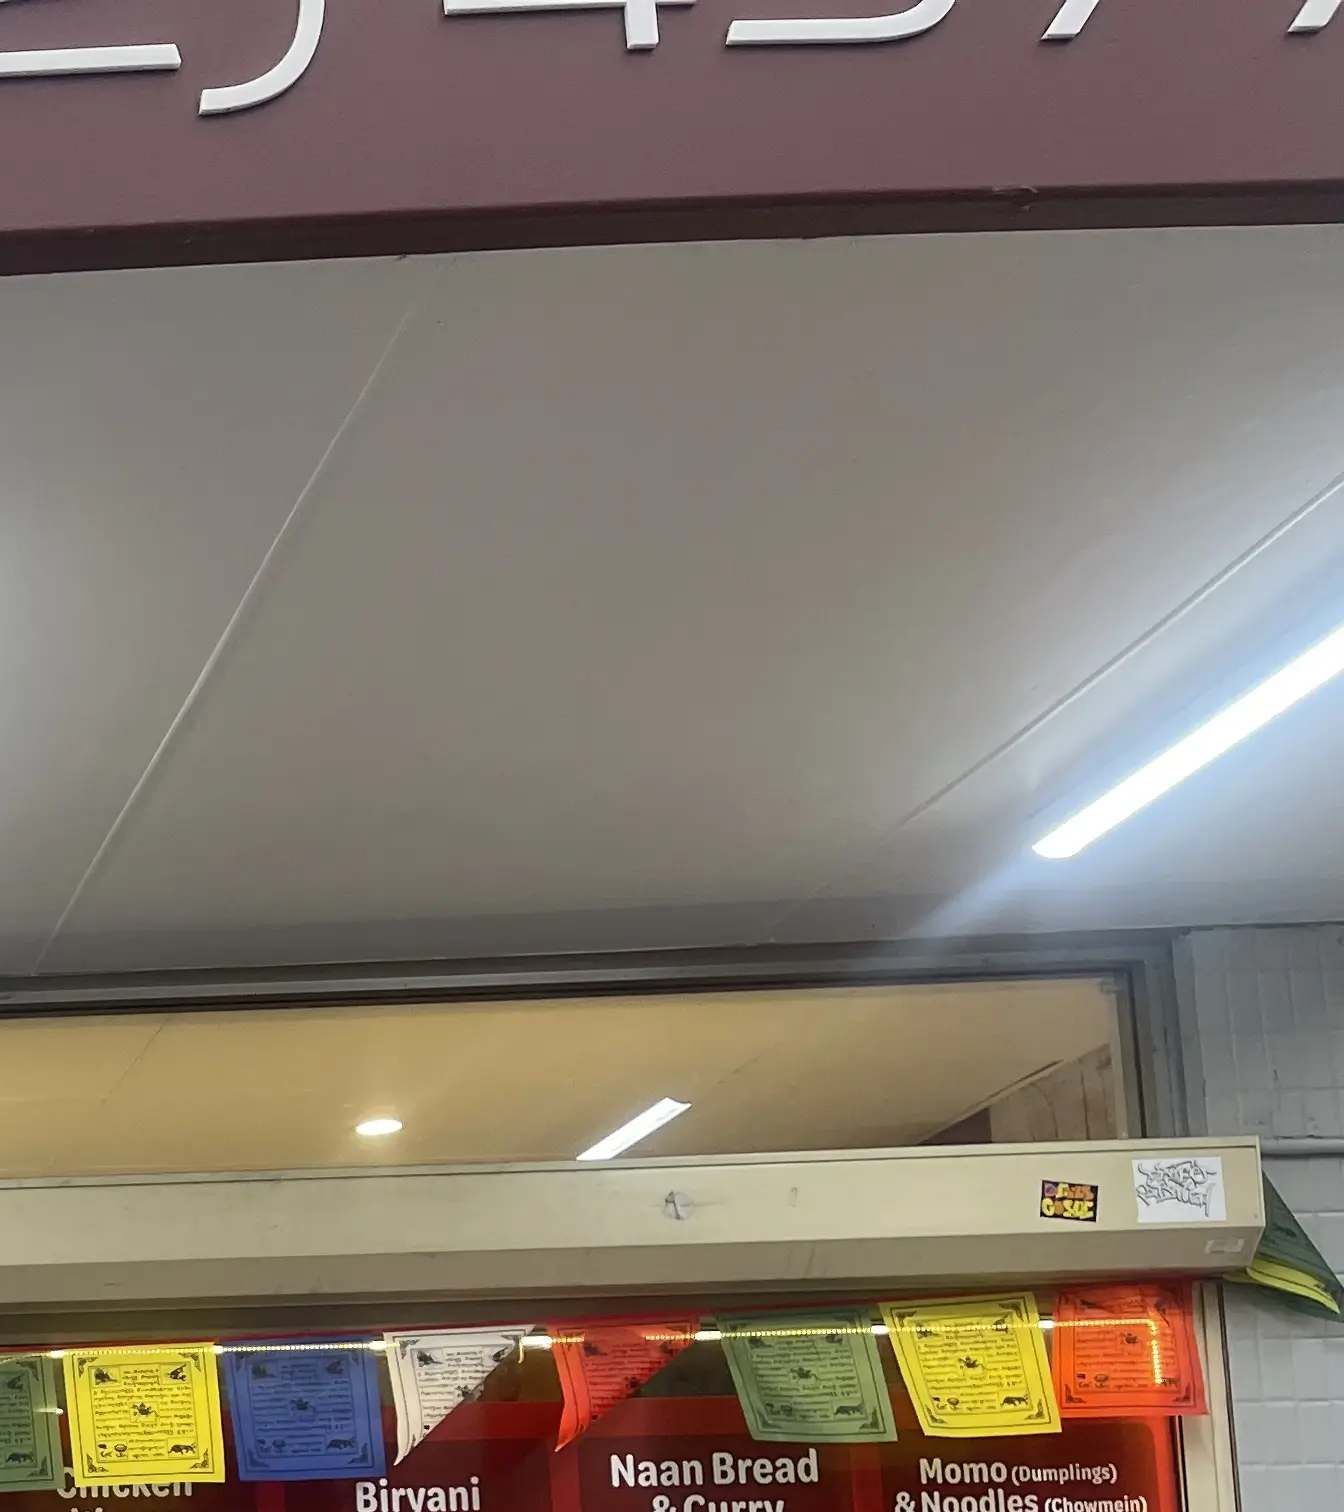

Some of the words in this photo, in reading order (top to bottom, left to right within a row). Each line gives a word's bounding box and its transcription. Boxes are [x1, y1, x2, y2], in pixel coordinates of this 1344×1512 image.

[610, 1453, 704, 1488] Naan
[712, 1448, 819, 1485] Bread
[919, 1458, 1008, 1484] Momo
[1011, 1463, 1117, 1486] (Dumplings)
